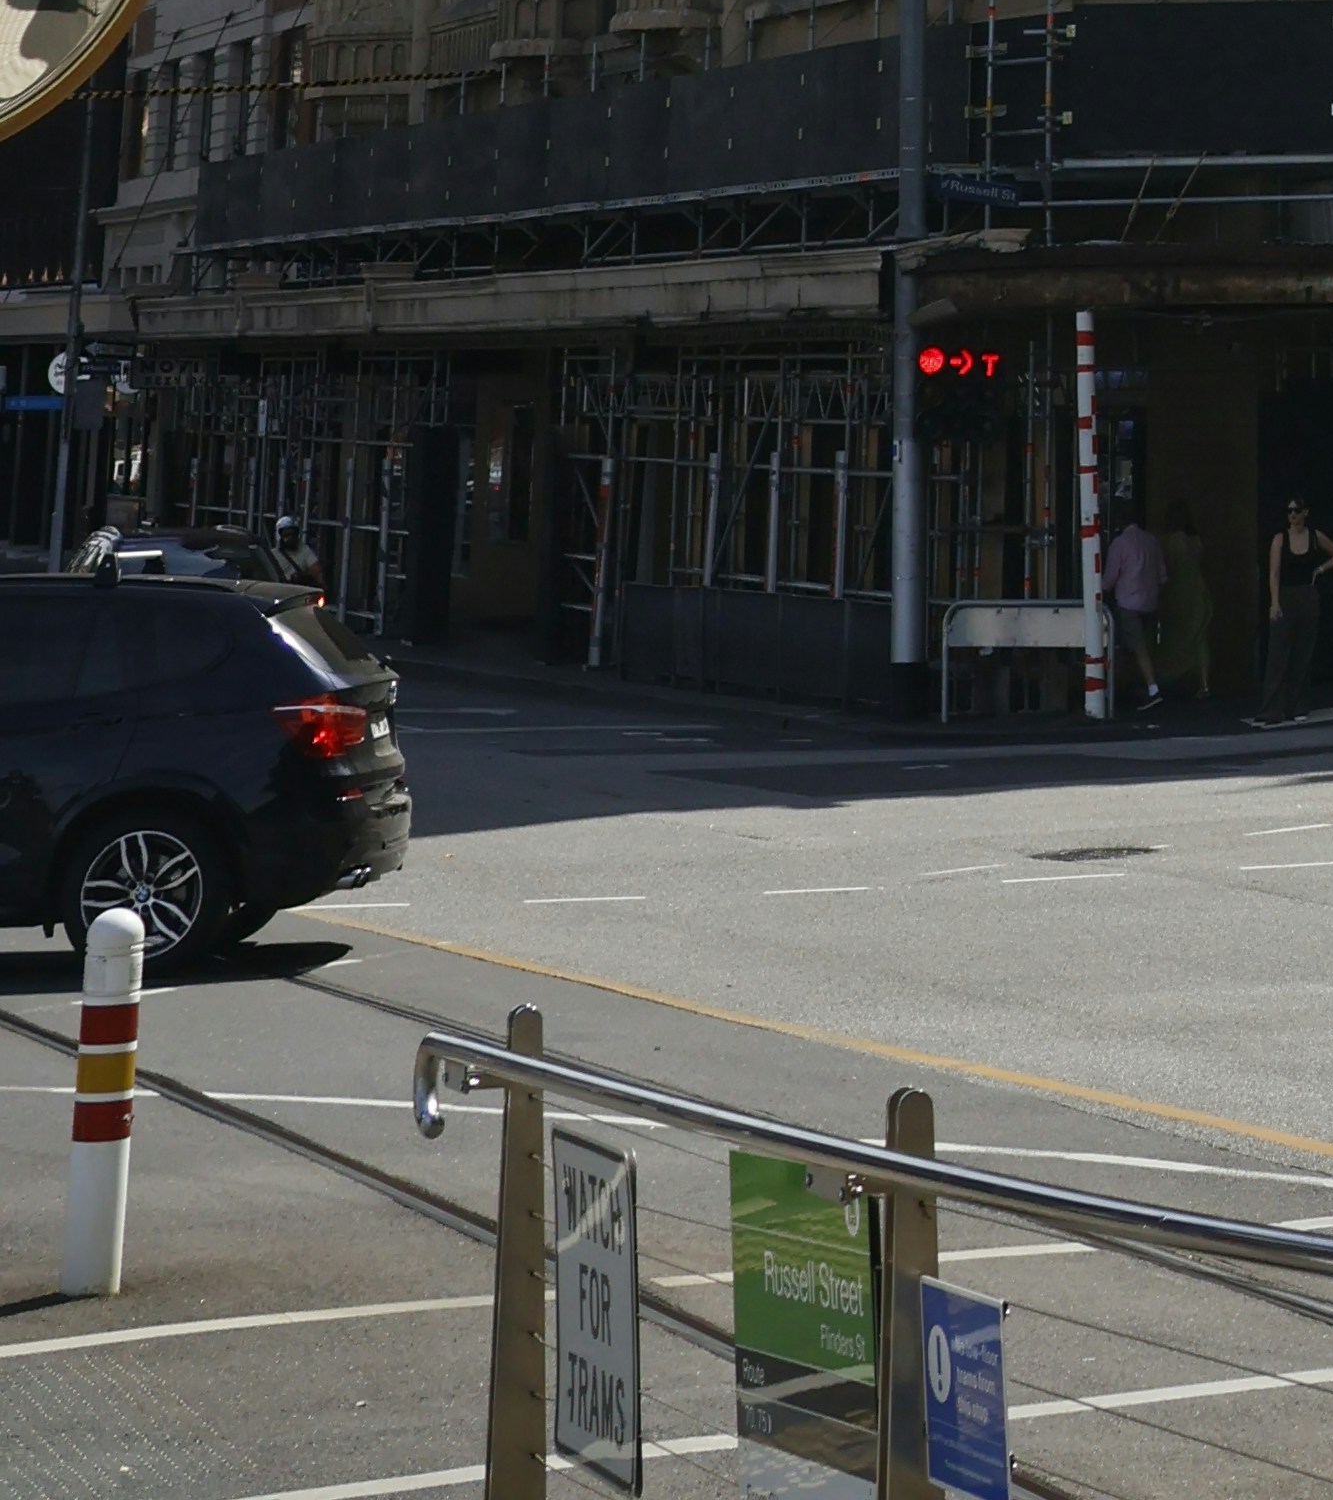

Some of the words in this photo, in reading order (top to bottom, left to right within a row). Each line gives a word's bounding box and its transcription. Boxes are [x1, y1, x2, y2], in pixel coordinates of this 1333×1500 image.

[950, 179, 999, 198] Russell
[1001, 188, 1016, 201] St
[563, 1163, 622, 1255] WATCH
[578, 1262, 612, 1347] FOR
[764, 1250, 816, 1304] Russell
[819, 1262, 864, 1317] Street
[742, 1357, 765, 1386] Route
[820, 1323, 854, 1359] Flinders
[855, 1333, 866, 1362] St
[567, 1351, 625, 1450] TRAMS
